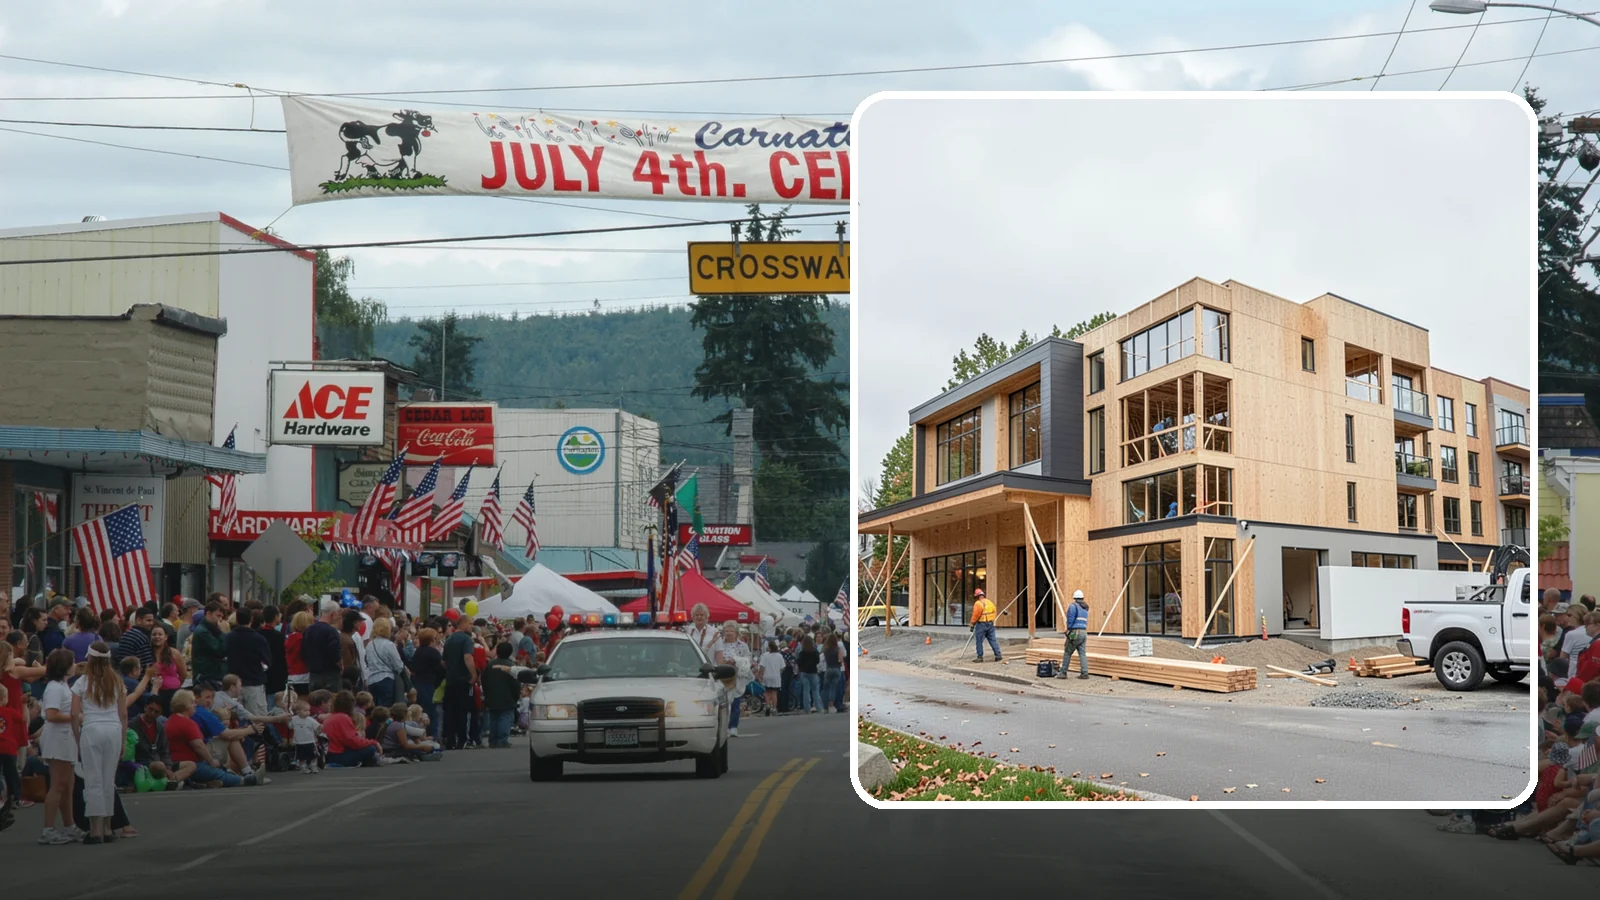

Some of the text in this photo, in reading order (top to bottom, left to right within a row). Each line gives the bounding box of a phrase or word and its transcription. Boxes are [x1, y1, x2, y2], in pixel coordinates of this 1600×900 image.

[481, 141, 604, 192] JULY
[632, 150, 746, 198] 4th.
[697, 254, 850, 280] CROSSWA
[283, 380, 373, 419] ACE
[405, 409, 485, 422] CEDAR LOG
[284, 421, 371, 437] Hardware
[416, 427, 476, 447] Coca-Cola
[354, 466, 386, 480] Simpl
[83, 485, 155, 495] St. Vincent de Paul
[688, 526, 741, 535] CRNATION
[699, 535, 730, 543] GLASS
